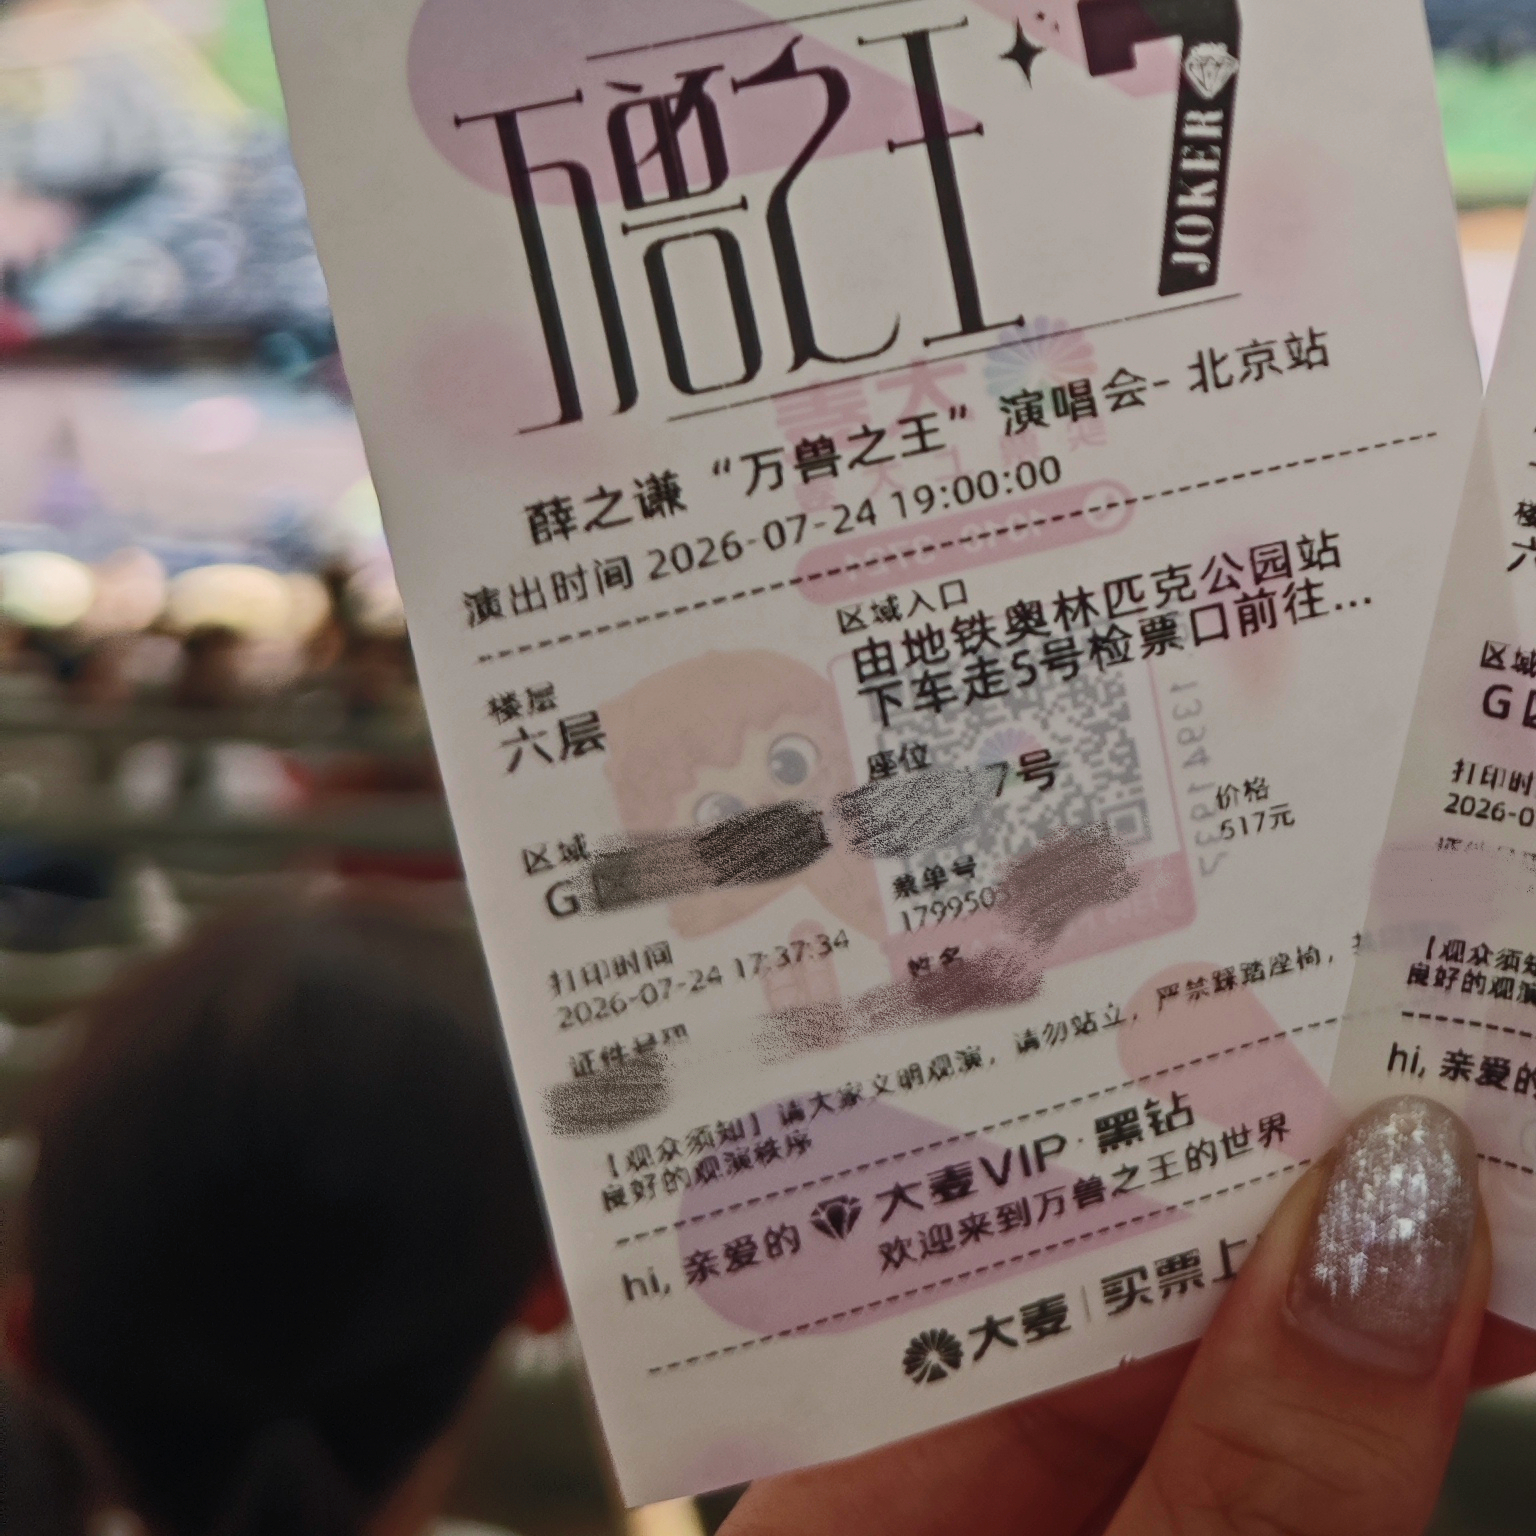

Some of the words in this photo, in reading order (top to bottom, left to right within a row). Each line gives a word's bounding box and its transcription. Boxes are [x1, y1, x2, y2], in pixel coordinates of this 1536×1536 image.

[1169, 109, 1225, 275] JOKER
[1187, 326, 1331, 394] 北京站
[461, 554, 635, 628] 演出时间
[647, 497, 877, 581] 2026-07-24
[891, 454, 1063, 520] 19:00:00
[836, 579, 968, 634] 区域入口
[852, 529, 1342, 684] 由地铁奥林匹克公园站
[487, 681, 558, 725] 楼层
[500, 709, 607, 773] 六层
[867, 742, 929, 783] 座位
[1215, 775, 1271, 812] 价格
[1220, 802, 1296, 842] 517元
[522, 832, 589, 876] 区域
[899, 884, 1010, 934] 179950
[549, 939, 674, 997] 打印时间
[557, 964, 724, 1030] 2026-07-24
[732, 927, 850, 979] 17:37:34
[1386, 1042, 1426, 1079] hi,
[878, 1111, 1292, 1273] 欢迎来到万兽之王的世界
[621, 1266, 673, 1302] hi,
[684, 1219, 802, 1285] 亲爱的
[968, 1294, 1073, 1364] 大麦
[1102, 1235, 1262, 1319] 买票上
